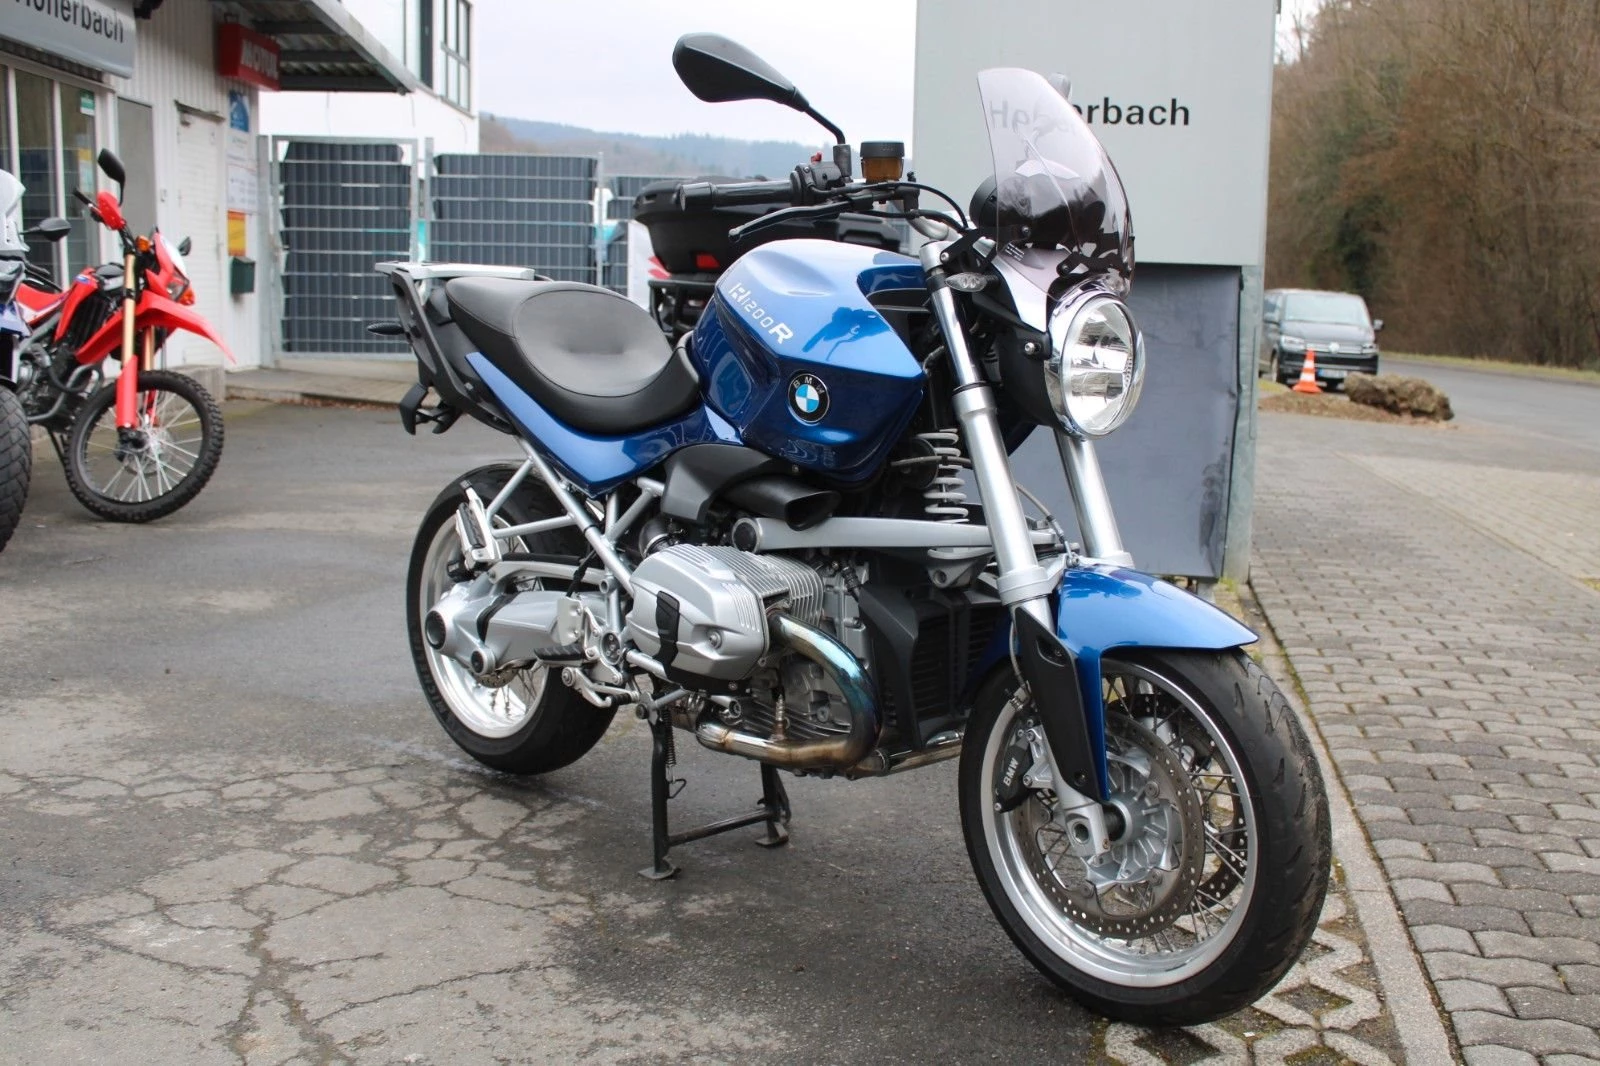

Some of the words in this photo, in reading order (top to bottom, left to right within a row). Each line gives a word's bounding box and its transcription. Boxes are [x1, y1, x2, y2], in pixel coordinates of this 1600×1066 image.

[15, 0, 124, 43] ollerbach
[240, 39, 279, 80] MOTUL
[793, 376, 825, 394] BMW
[1002, 757, 1019, 787] BMW
